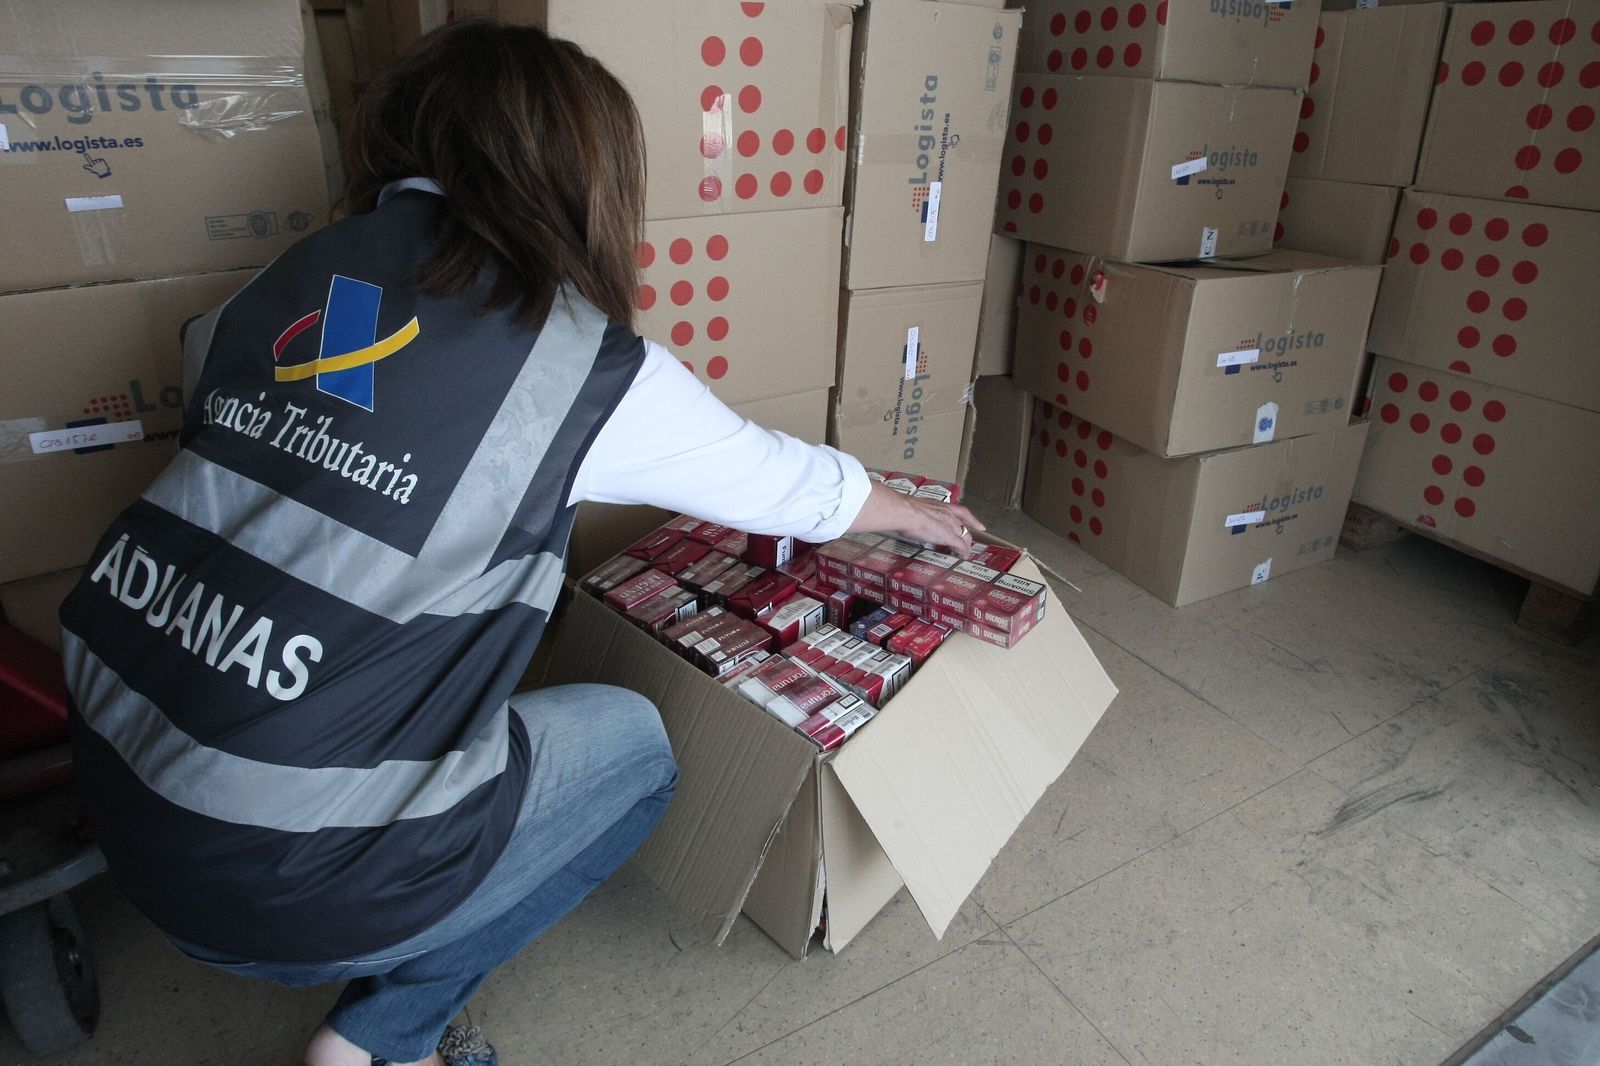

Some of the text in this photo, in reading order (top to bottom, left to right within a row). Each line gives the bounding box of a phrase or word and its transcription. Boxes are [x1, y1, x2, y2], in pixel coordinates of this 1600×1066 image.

[908, 75, 938, 184] Logista
[938, 112, 950, 182] www.logista.es
[1256, 330, 1325, 356] Logista
[1250, 360, 1297, 371] www.logista.es
[904, 374, 930, 460] Logista
[269, 402, 418, 504] Tributaria
[1261, 486, 1324, 512] Logista
[956, 565, 993, 581] Smoking
[972, 564, 989, 573] kills
[996, 579, 1035, 596] Smoking
[1014, 577, 1031, 587] kills
[902, 584, 923, 598] DUCADOS
[942, 597, 965, 611] DUCADOS
[90, 533, 323, 701] ADUANAS
[942, 614, 963, 628] DUCADOS
[985, 612, 1008, 627] DUCADOS
[983, 629, 1007, 644] DUCADOS
[771, 669, 808, 692] Fortuna
[800, 687, 837, 711] Fortuna
